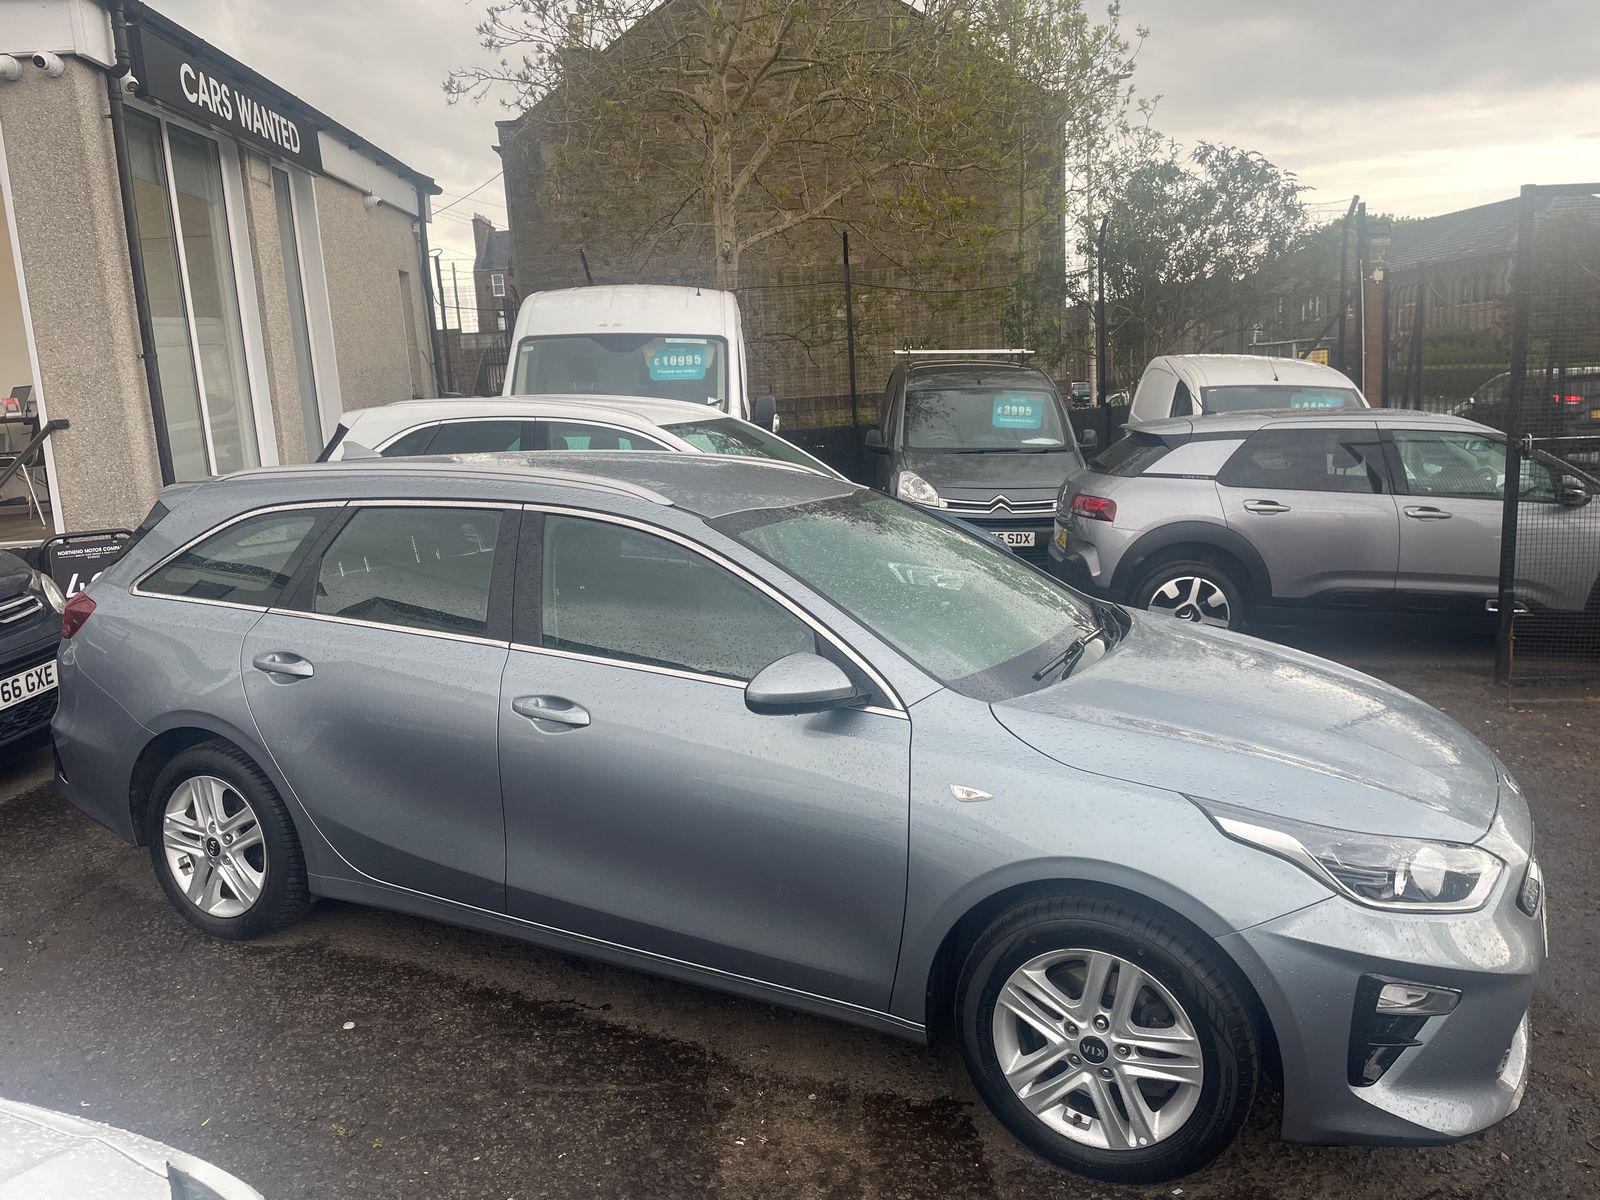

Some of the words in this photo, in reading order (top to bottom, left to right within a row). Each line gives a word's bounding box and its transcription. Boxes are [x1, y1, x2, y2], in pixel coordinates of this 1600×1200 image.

[180, 63, 233, 121] CARS
[234, 91, 301, 154] WANTED
[1007, 533, 1031, 544] SDX
[0, 678, 22, 702] 66
[25, 664, 54, 693] GXE
